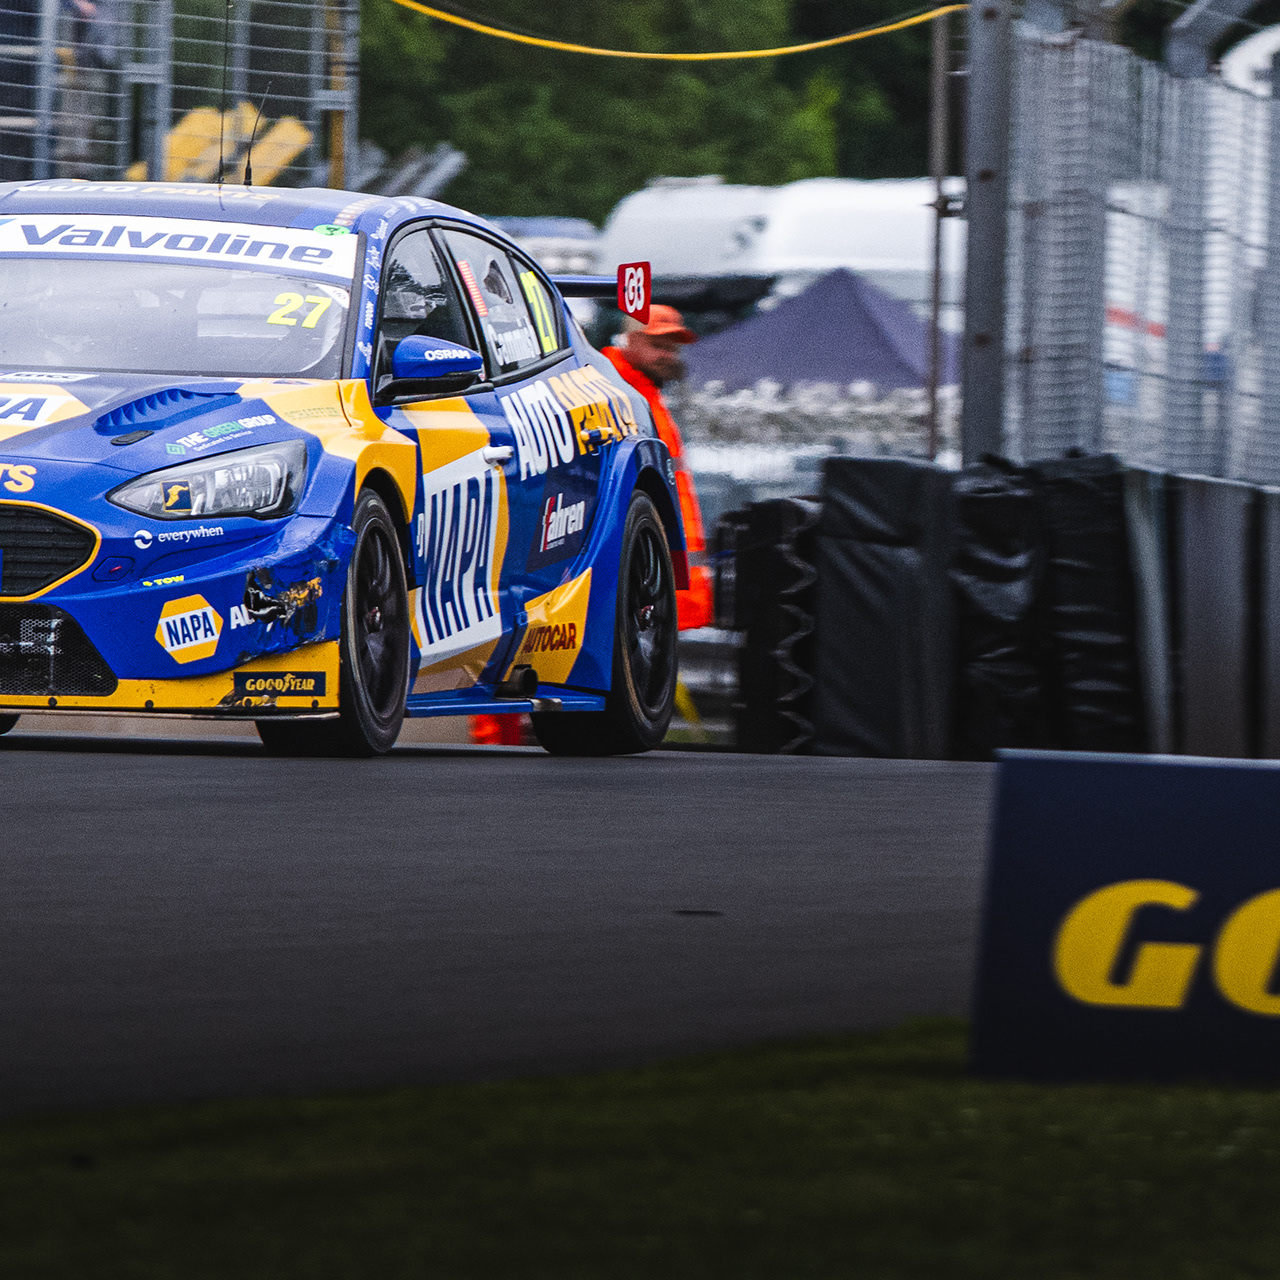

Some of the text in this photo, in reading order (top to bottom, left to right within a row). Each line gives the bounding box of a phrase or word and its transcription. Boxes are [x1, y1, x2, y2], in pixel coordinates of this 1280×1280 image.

[140, 187, 280, 200] PARTS
[21, 224, 333, 264] Valvoline
[266, 292, 332, 329] 27
[424, 349, 471, 361] OSRAM
[176, 414, 277, 448] THE GREEN GROUP
[501, 379, 575, 481] AUTO
[158, 525, 224, 543] everywhen
[540, 492, 586, 552] fahren
[421, 468, 494, 645] NAPA
[154, 575, 185, 586] TOW
[165, 611, 215, 648] NAPA
[522, 622, 577, 653] AUTOCAR
